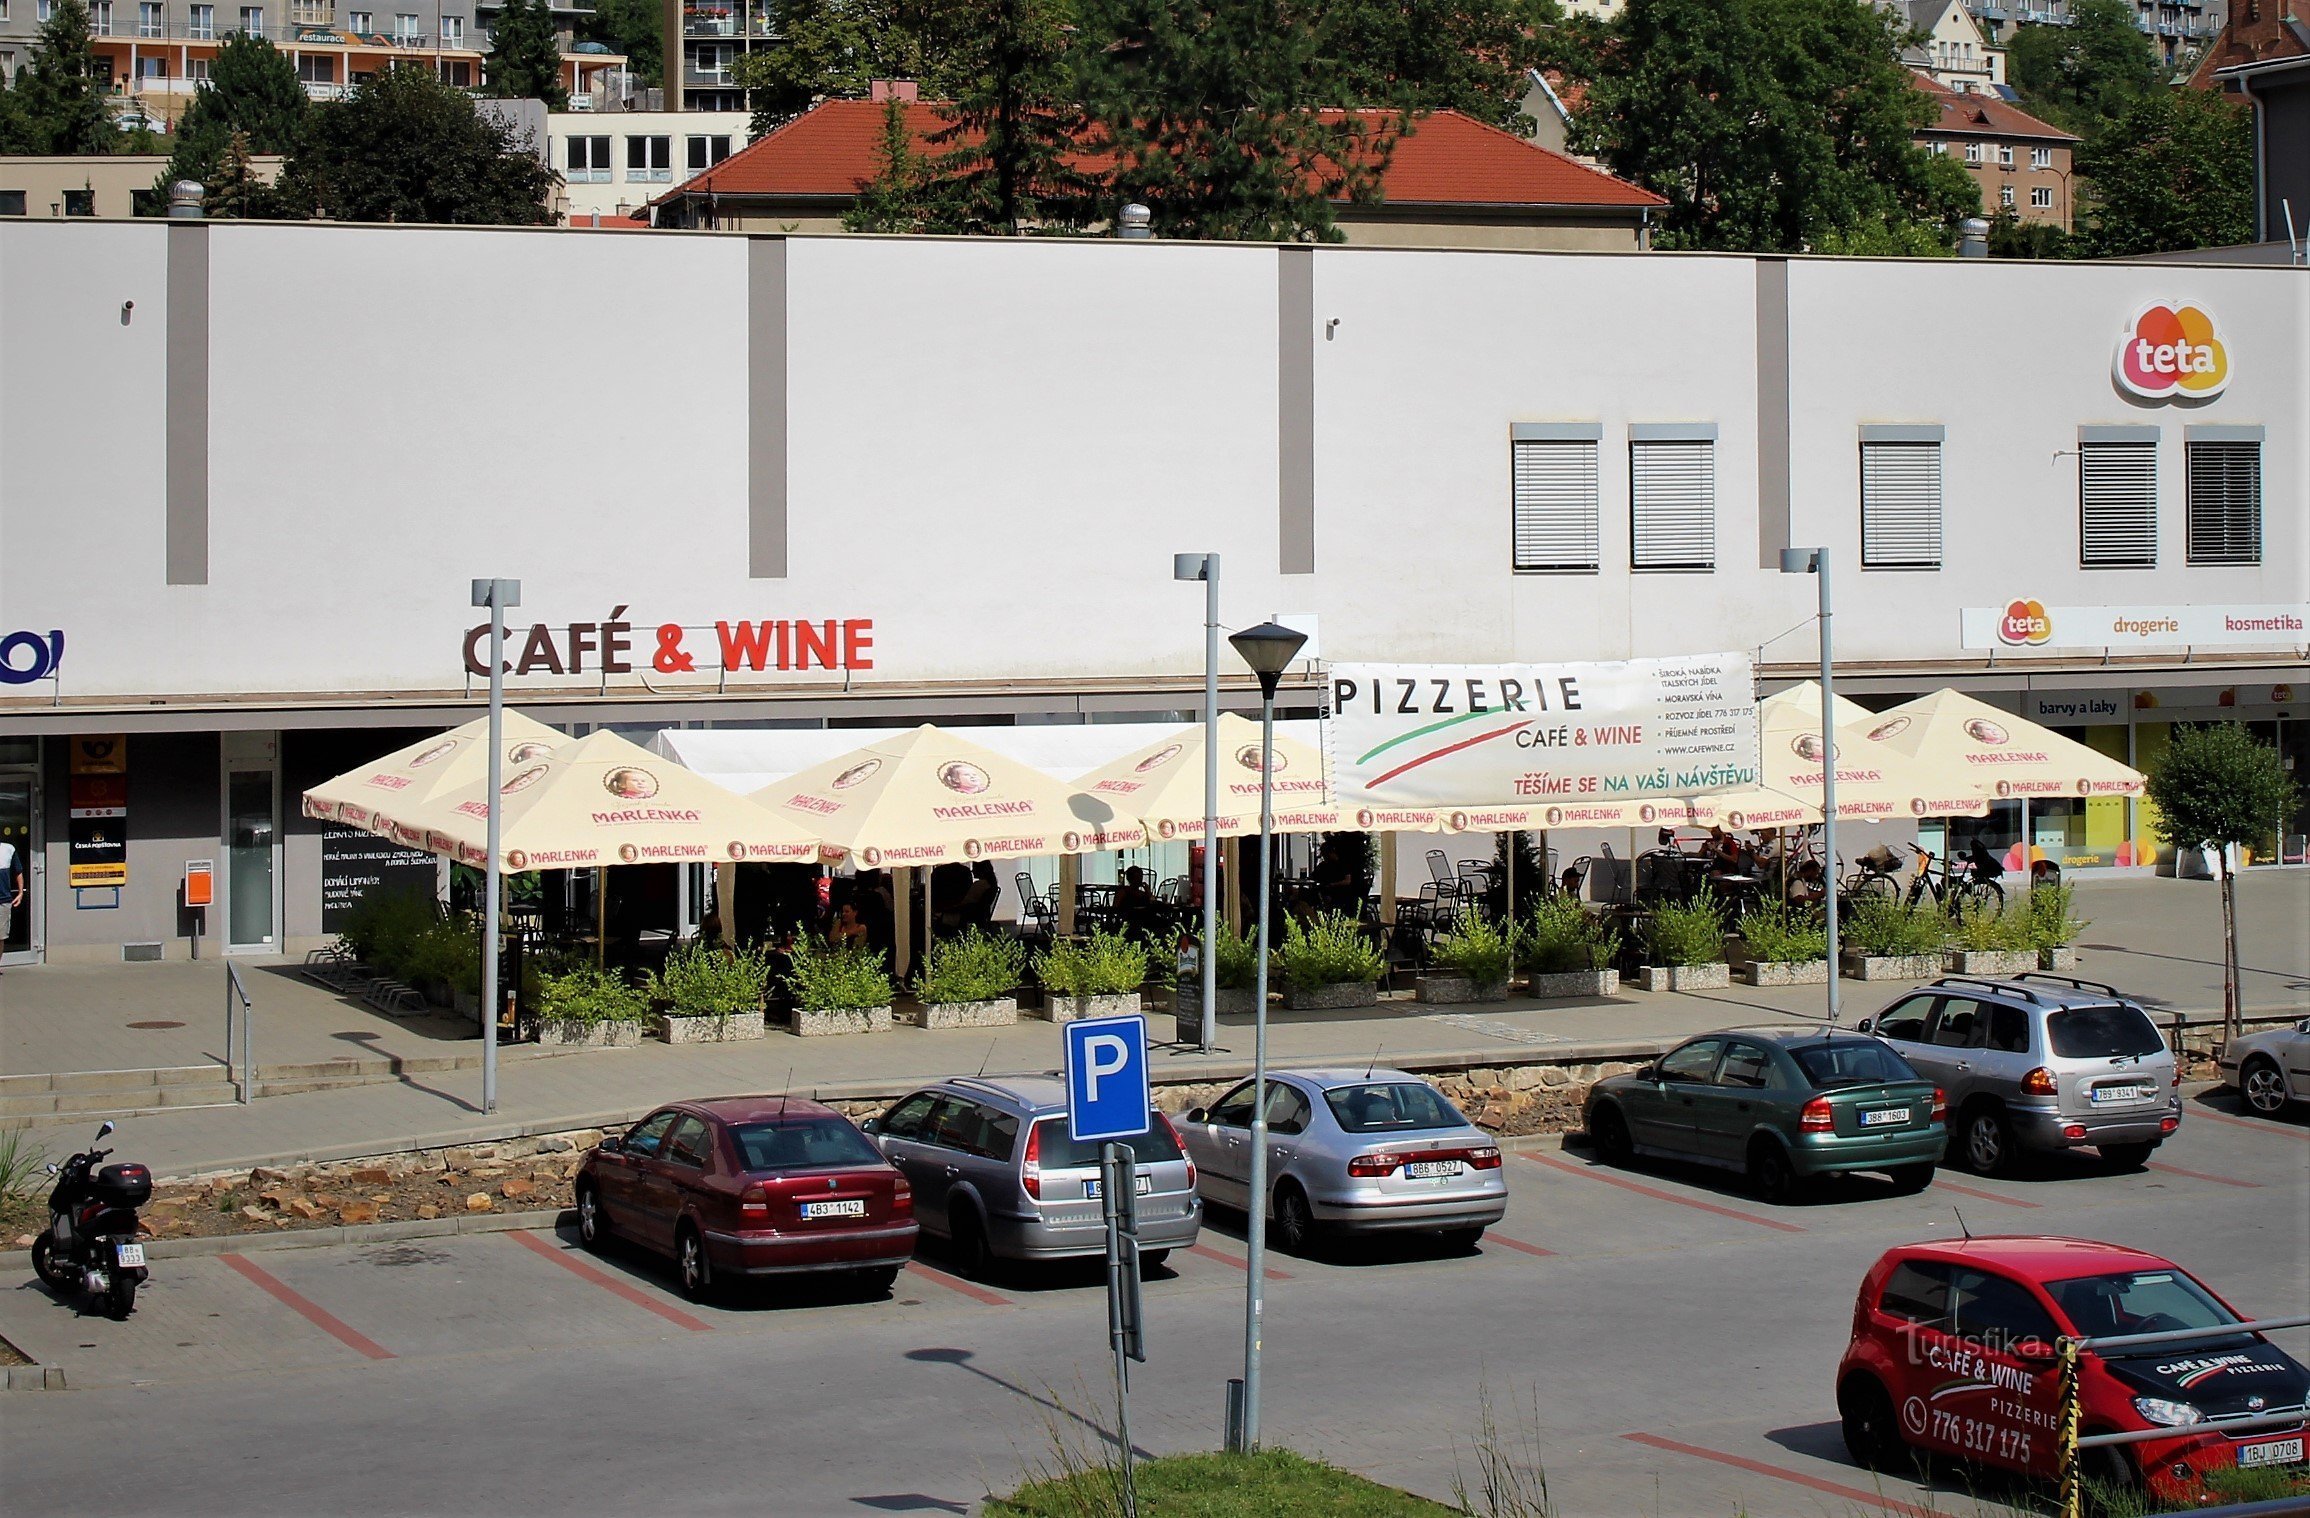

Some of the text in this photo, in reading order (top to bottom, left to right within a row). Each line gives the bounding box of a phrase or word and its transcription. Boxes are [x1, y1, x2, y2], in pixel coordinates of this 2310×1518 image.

[300, 33, 345, 43] restaurace
[2136, 338, 2216, 373] teta
[2007, 614, 2304, 637] teta drogerie kosmetika
[462, 604, 874, 677] CAFÉ & WINE
[1659, 664, 1722, 678] ŠIROKÁ NABÍDKA
[1661, 675, 1719, 688] ITALSKÝCH JÍDEL
[1334, 677, 1583, 715] PIZZERIE
[1665, 690, 1723, 703] MORAVSKÁ VÍNA
[1665, 710, 1694, 721] ROZVOZ
[1696, 708, 1713, 720] JÍDEL
[1715, 709, 1727, 718] 776
[1730, 708, 1740, 717] 317
[2039, 699, 2117, 717] barvy a laky
[1700, 723, 1736, 736] PROSTŘEDÍ
[1515, 725, 1642, 748] CAFÉ & WINE
[1665, 743, 1735, 755] WWW.CAFEWINE.CZ
[1514, 762, 1754, 795] TĚŠÍME SE NA VAŠI NÁVŠTĚVU
[2062, 853, 2100, 866] drogerie
[1084, 1034, 1128, 1103] P
[2099, 1087, 2135, 1099] 7B9 9341
[1888, 1110, 1906, 1121] 1603
[1413, 1161, 1458, 1174] 8B6 0527
[810, 1202, 859, 1215] 4B3 1142
[121, 1254, 141, 1262] 9333
[2210, 1354, 2252, 1367] WINE
[1930, 1345, 2034, 1395] CAFÉ & WINE
[2226, 1363, 2286, 1375] PIZZERIE
[1991, 1397, 2058, 1431] PIZZERIE
[1933, 1409, 2031, 1464] 776 317 175
[2247, 1442, 2298, 1461] 1BJ 0708
